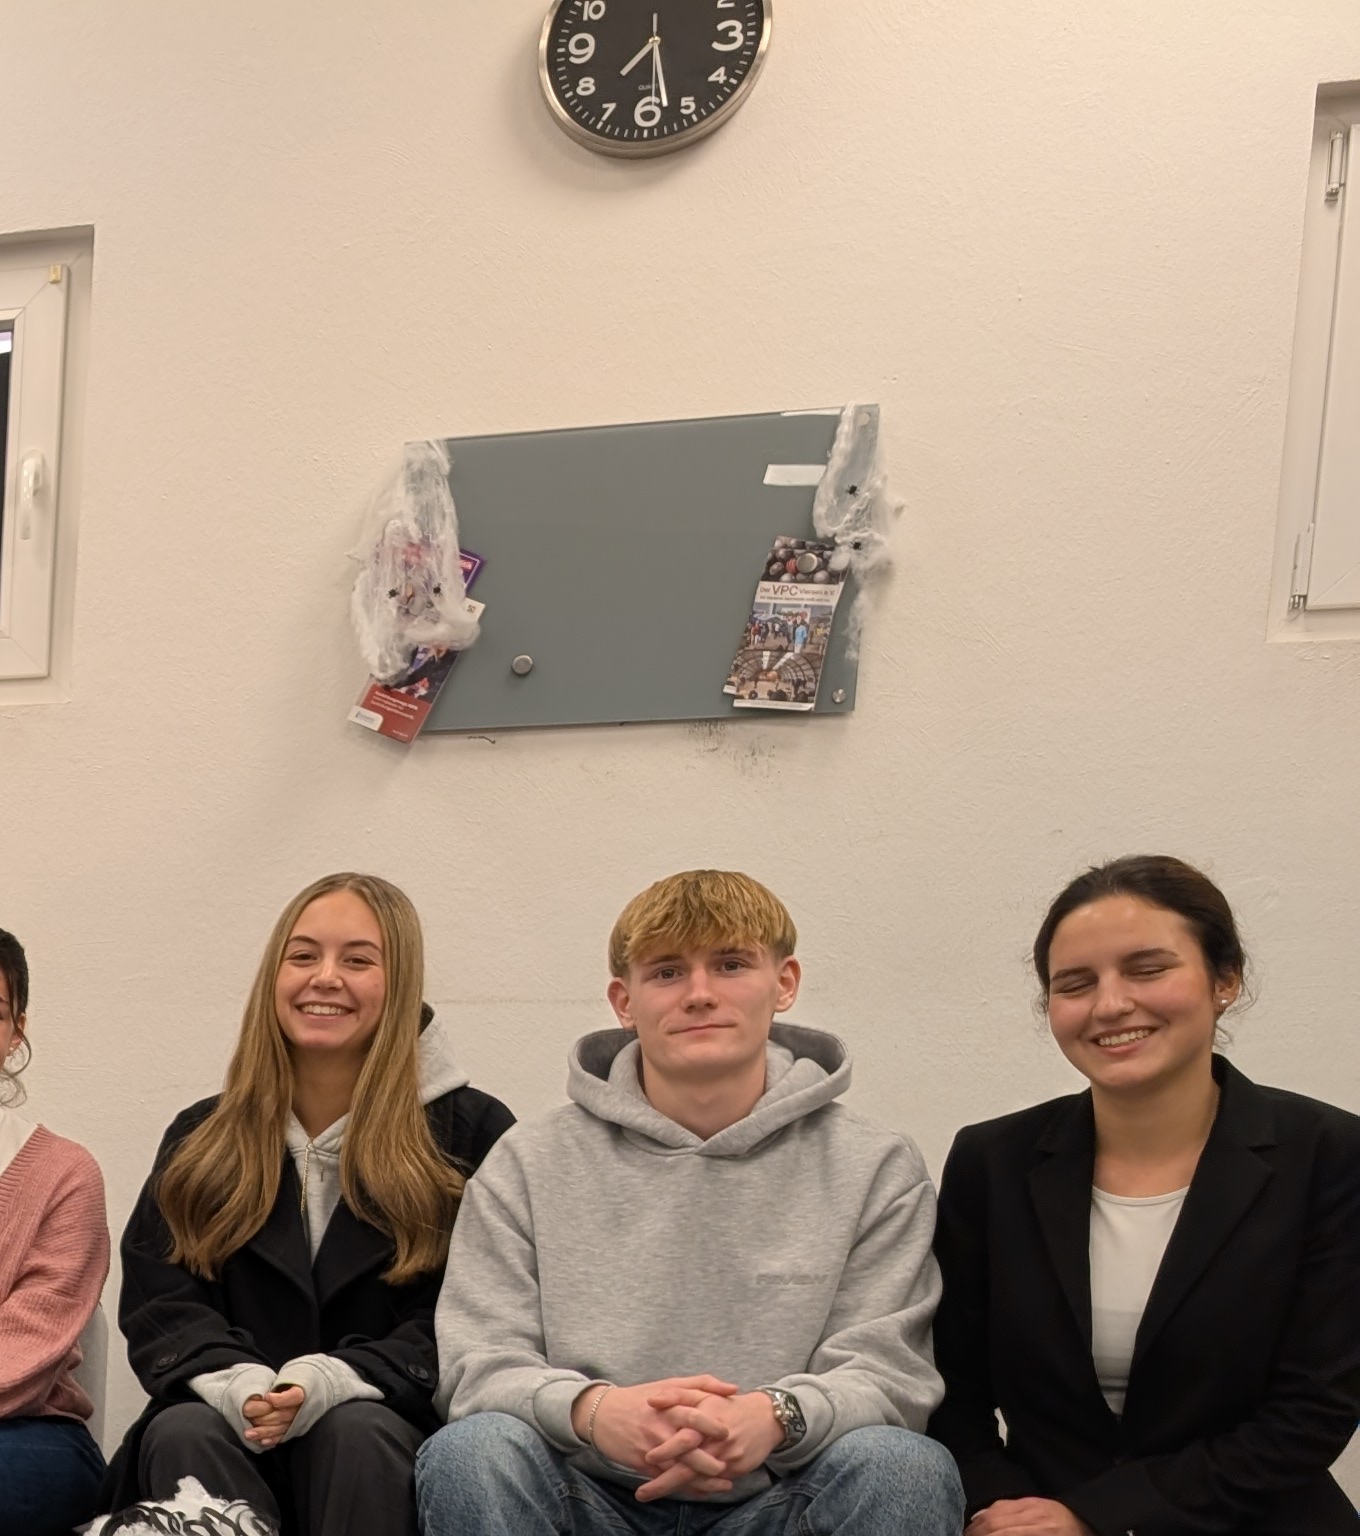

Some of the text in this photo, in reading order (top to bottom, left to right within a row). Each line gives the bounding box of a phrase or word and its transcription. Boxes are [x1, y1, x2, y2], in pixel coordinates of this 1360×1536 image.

[582, 0, 606, 21] 10
[711, 19, 744, 52] 3
[568, 32, 596, 64] 9
[707, 66, 728, 85] 4
[575, 76, 597, 97] 8
[601, 102, 617, 122] 7
[633, 95, 662, 127] 6
[680, 96, 697, 115] 5
[772, 584, 799, 596] VPC
